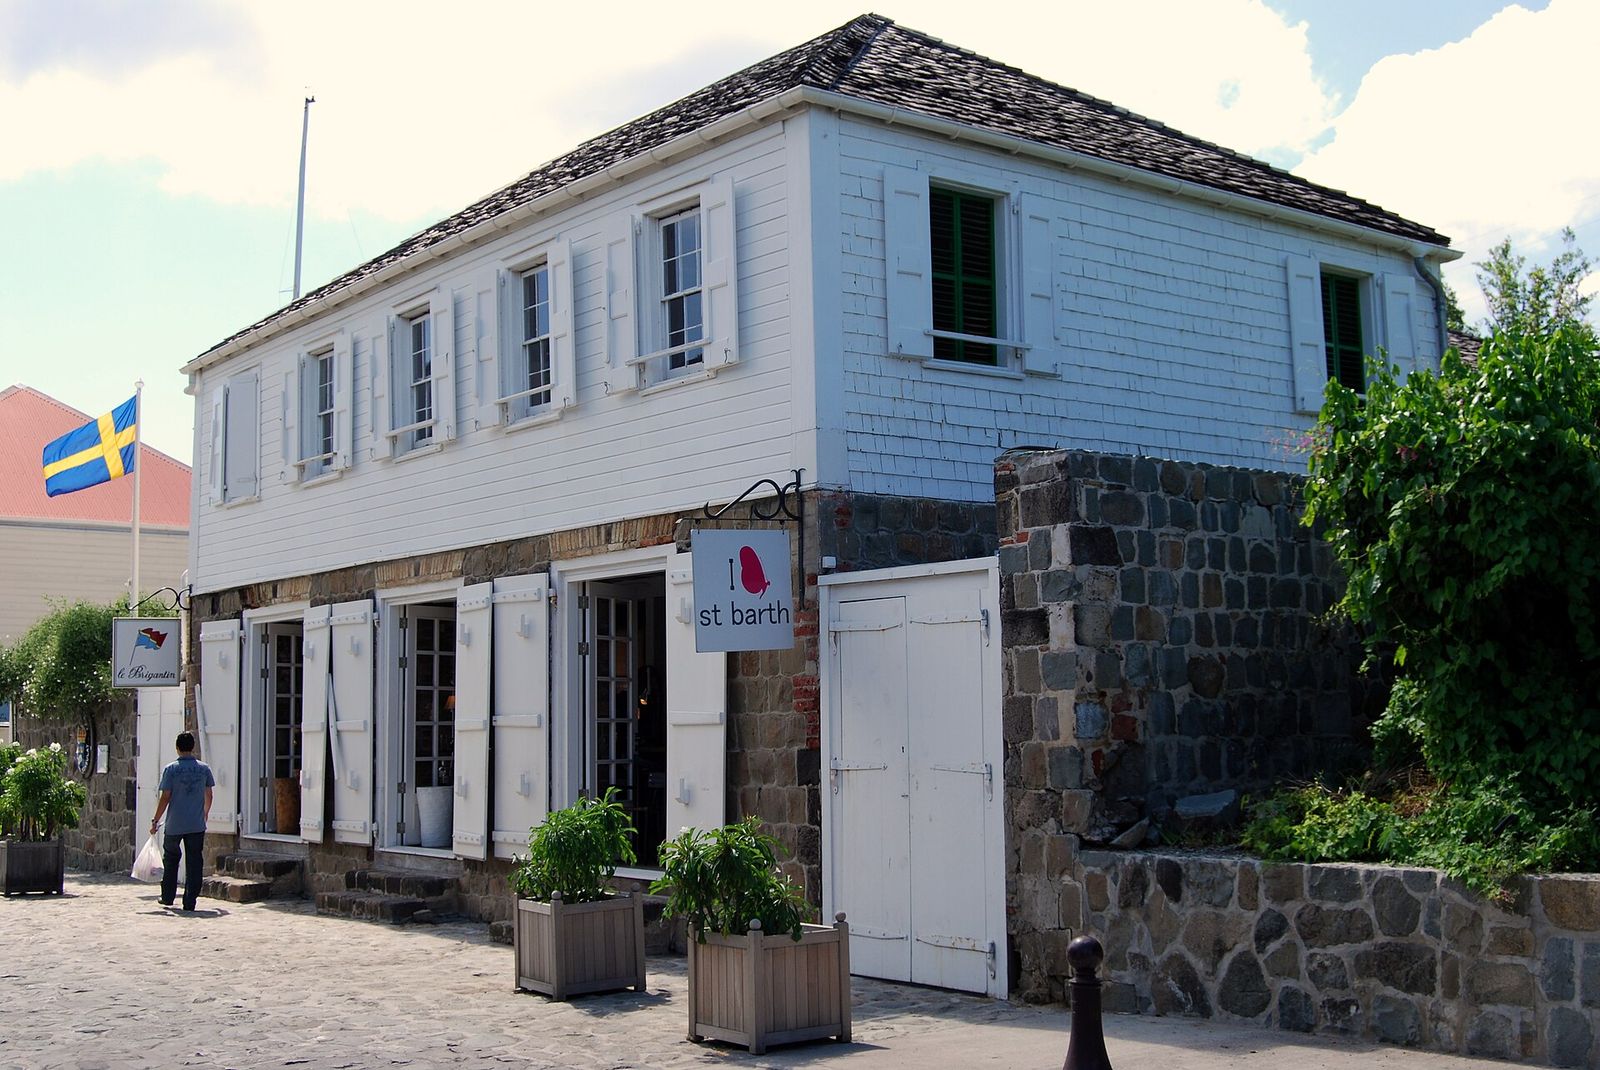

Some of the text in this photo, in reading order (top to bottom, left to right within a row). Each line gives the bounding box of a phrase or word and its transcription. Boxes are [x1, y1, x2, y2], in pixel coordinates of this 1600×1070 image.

[700, 600, 789, 626] st barth
[128, 665, 176, 681] Brigantin
